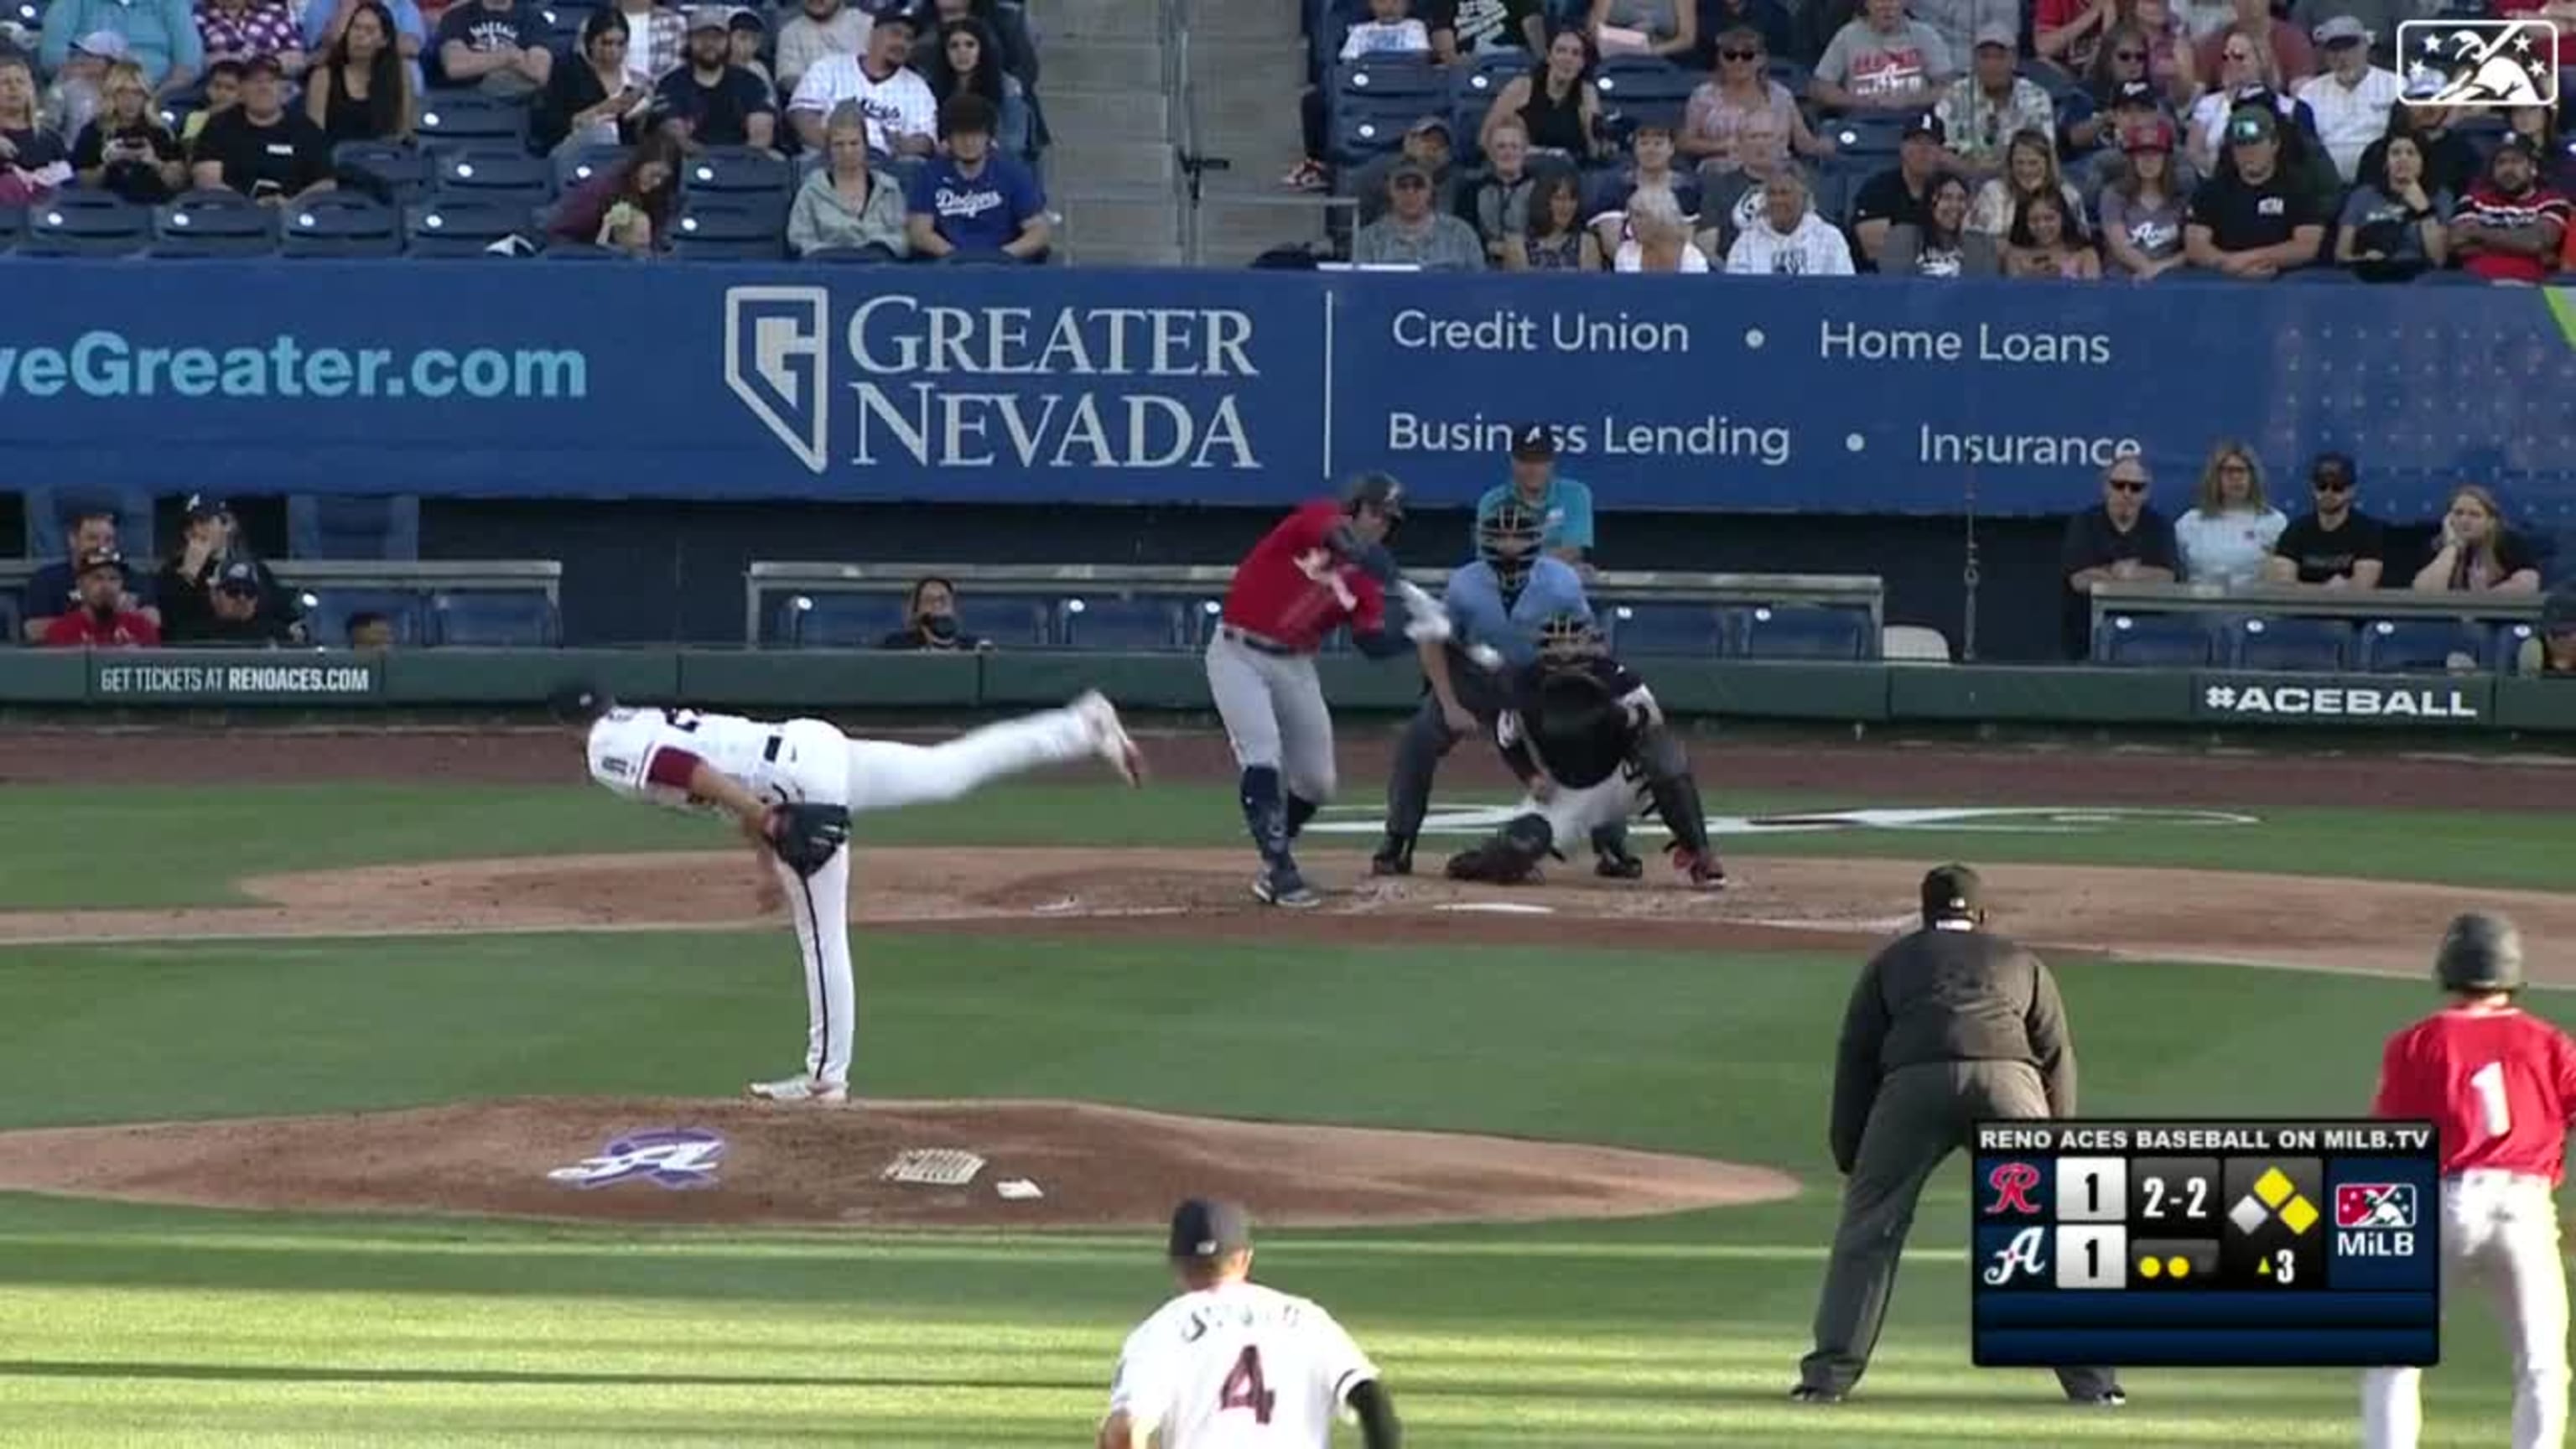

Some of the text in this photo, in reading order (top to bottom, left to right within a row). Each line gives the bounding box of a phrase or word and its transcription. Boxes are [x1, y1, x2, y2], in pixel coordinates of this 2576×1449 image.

[935, 186, 1002, 218] Dodgers
[848, 294, 1261, 377] GREATER
[1392, 309, 2111, 363] Credit Union Home Loans
[847, 381, 1264, 469] NEVADA
[1389, 412, 2142, 467] Businss Lending Insurance
[101, 666, 370, 693] GET TICKETS AT RENOACES.COM
[2205, 686, 2479, 717] #ACEBALL
[2470, 1061, 2512, 1138] 1
[1219, 1343, 1275, 1426] 4
